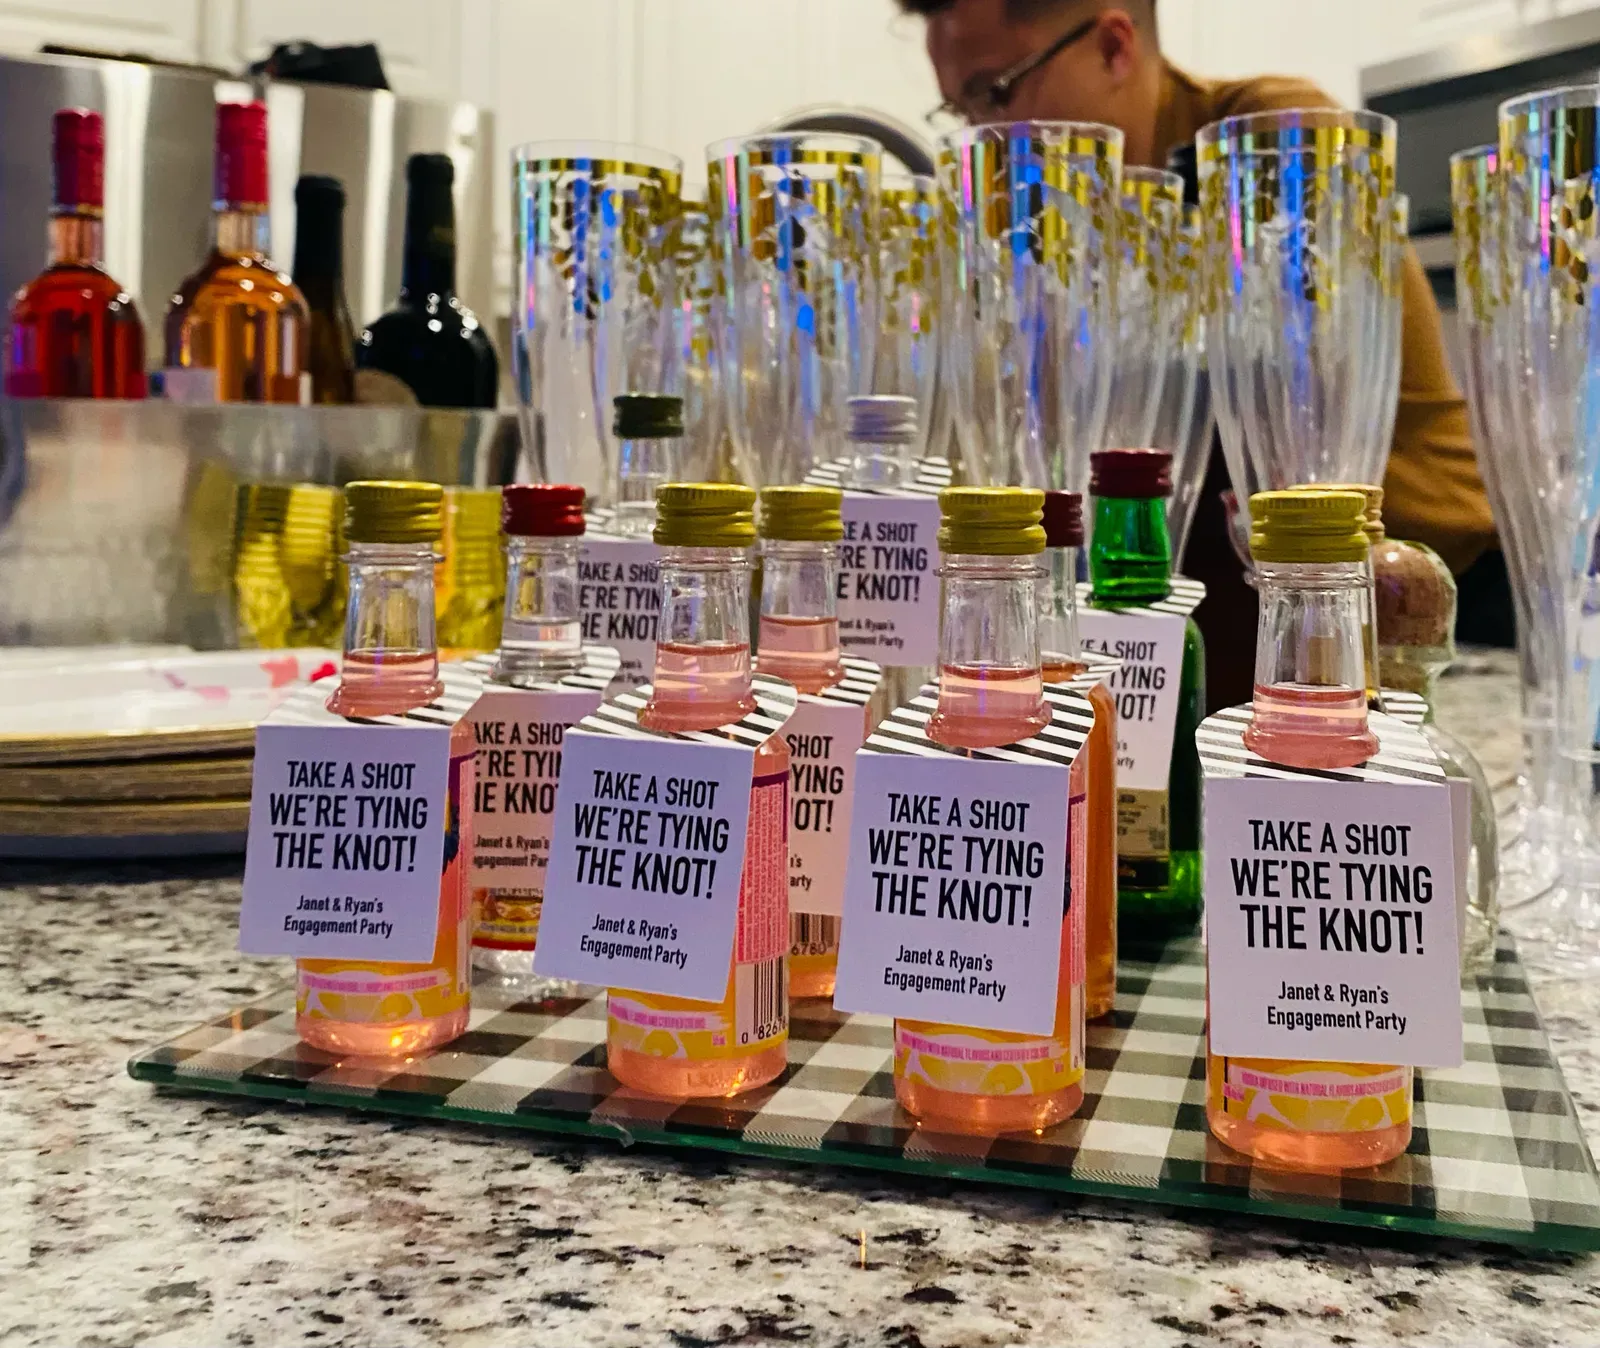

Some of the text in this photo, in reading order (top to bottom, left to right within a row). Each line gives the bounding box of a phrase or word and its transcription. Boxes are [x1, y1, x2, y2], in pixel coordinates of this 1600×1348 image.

[861, 521, 872, 542] A
[876, 522, 918, 543] SHOT
[836, 544, 928, 572] 'RE TYING
[614, 563, 624, 581] A
[628, 563, 659, 582] SHO
[580, 585, 660, 610] E'RE TYIN
[856, 574, 920, 602] KNOT!
[580, 612, 658, 641] HE KNOT
[1115, 640, 1156, 662] SHOT
[1116, 694, 1156, 722] OT!
[510, 723, 521, 744] A
[786, 734, 833, 758] SHOT
[287, 761, 415, 790] TAKE A SHOT
[1116, 756, 1135, 770] arty
[594, 770, 719, 809] TAKE A SHOT
[792, 764, 844, 795] YING
[270, 793, 428, 829] WE'RE TYING
[504, 782, 559, 814] KNO
[791, 799, 834, 832] OT!
[888, 793, 1030, 832] TAKE A SHOT
[475, 834, 502, 848] Janet
[506, 836, 512, 848] &
[575, 803, 729, 853] WE'RE TYING
[1249, 820, 1411, 856] TAKE A SHOT
[273, 832, 416, 872] THE KNOT!
[530, 854, 548, 867] Par
[869, 829, 1044, 878] WE'RE TYING
[576, 845, 716, 899] THE KNOT!
[790, 875, 812, 892] arty
[1231, 858, 1432, 904] WE'RE TYING
[297, 895, 383, 916] Janet & Ryan's
[872, 872, 1032, 927] THE KNOT!
[284, 915, 393, 939] Engagement Party
[592, 914, 677, 941] Janet & Ryan's
[1240, 904, 1423, 954] THE KNOT!
[581, 935, 687, 969] Engagement Party
[896, 945, 992, 973] Janet & Ryan's
[884, 968, 1006, 1002] Engagement Party
[1278, 981, 1388, 1007] Janet & Ryan's
[742, 1032, 748, 1044] 0
[758, 1016, 787, 1040] 82678
[1268, 1006, 1406, 1035] Engagement Party
